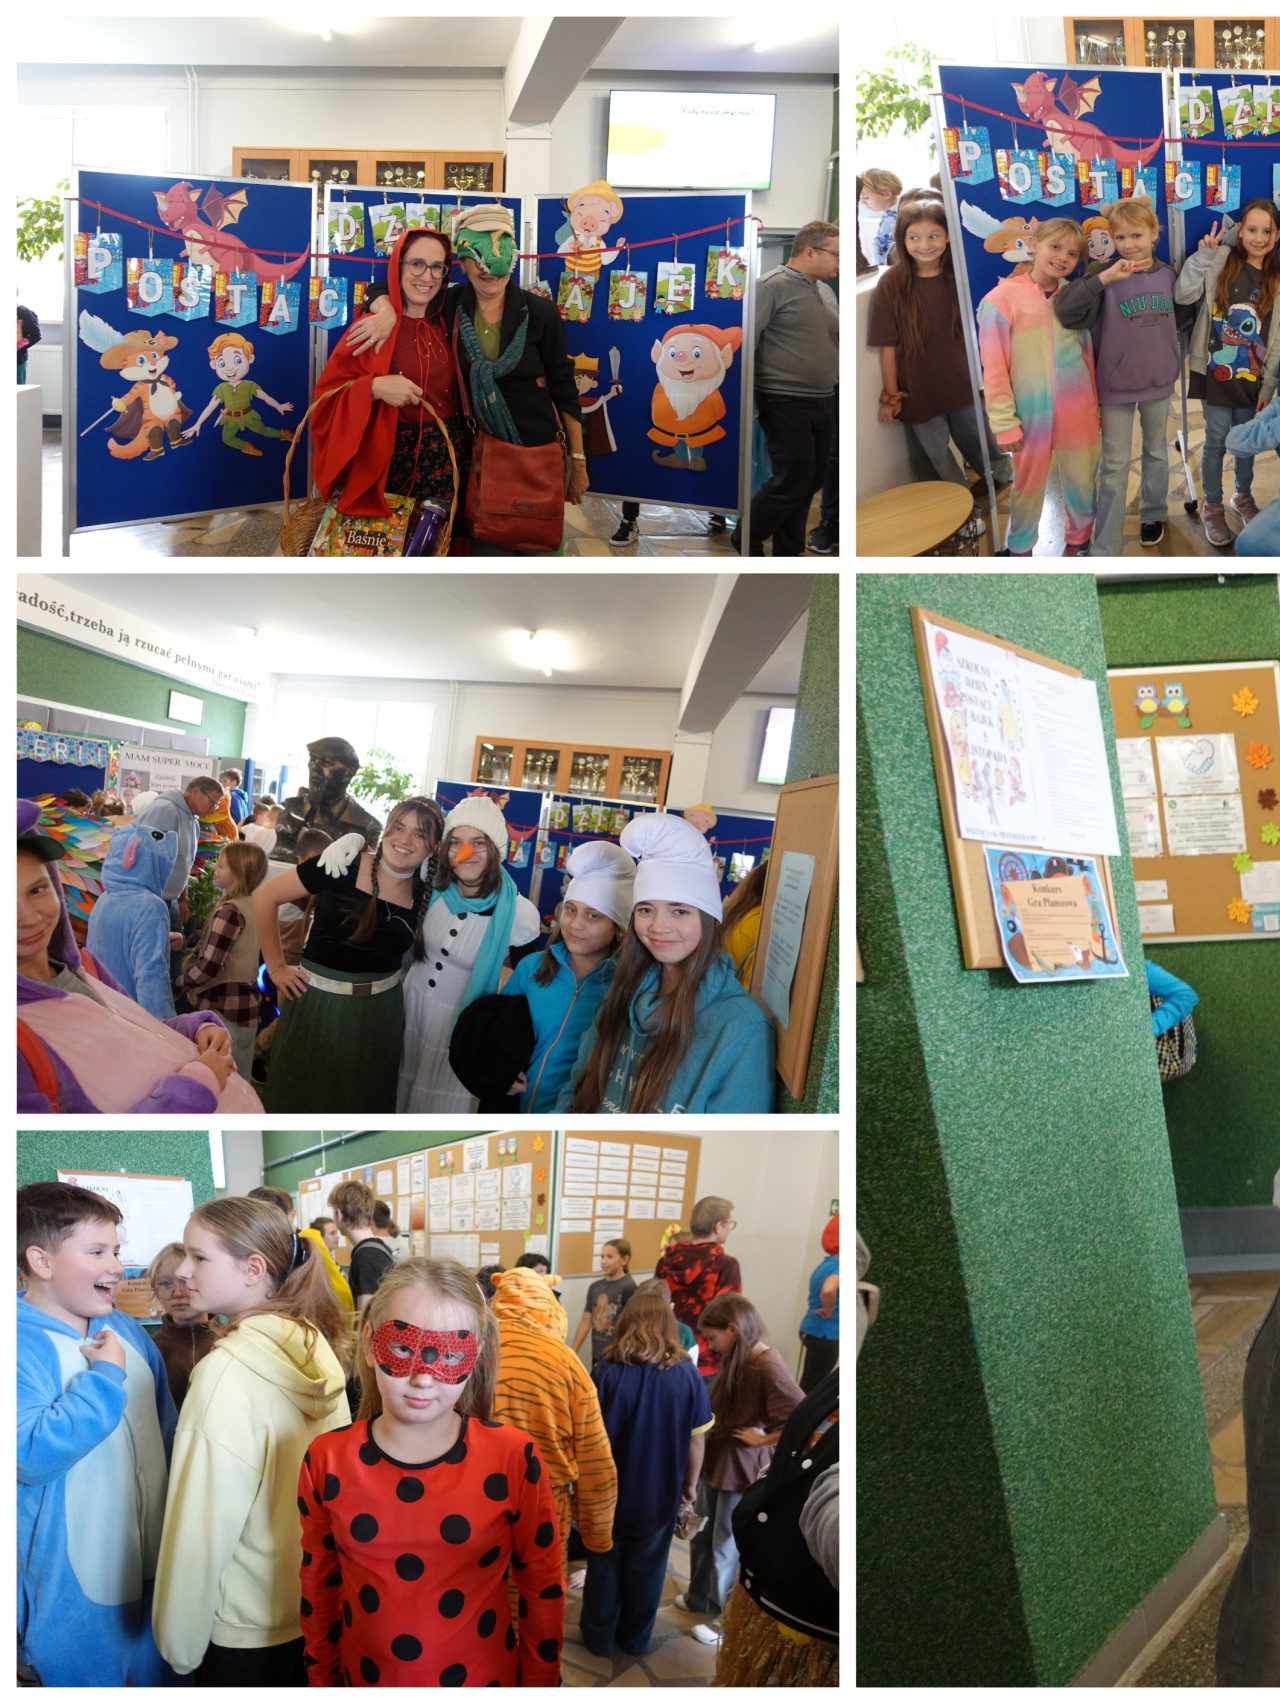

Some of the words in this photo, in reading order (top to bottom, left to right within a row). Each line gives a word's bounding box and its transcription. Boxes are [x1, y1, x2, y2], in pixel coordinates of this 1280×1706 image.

[959, 140, 1229, 202] POSTACI
[88, 248, 340, 323] POSTAC
[564, 258, 739, 311] AJEK
[1119, 294, 1146, 317] NIU
[347, 530, 387, 547] Baśnie
[117, 628, 131, 647] ją
[134, 638, 172, 659] rzucać
[956, 656, 991, 678] SZKOLNY
[125, 751, 150, 763] MAM
[152, 755, 181, 767] SUPER
[1031, 883, 1062, 894] Konkurs
[1028, 897, 1042, 907] Gra
[1043, 897, 1078, 908] Planszowa
